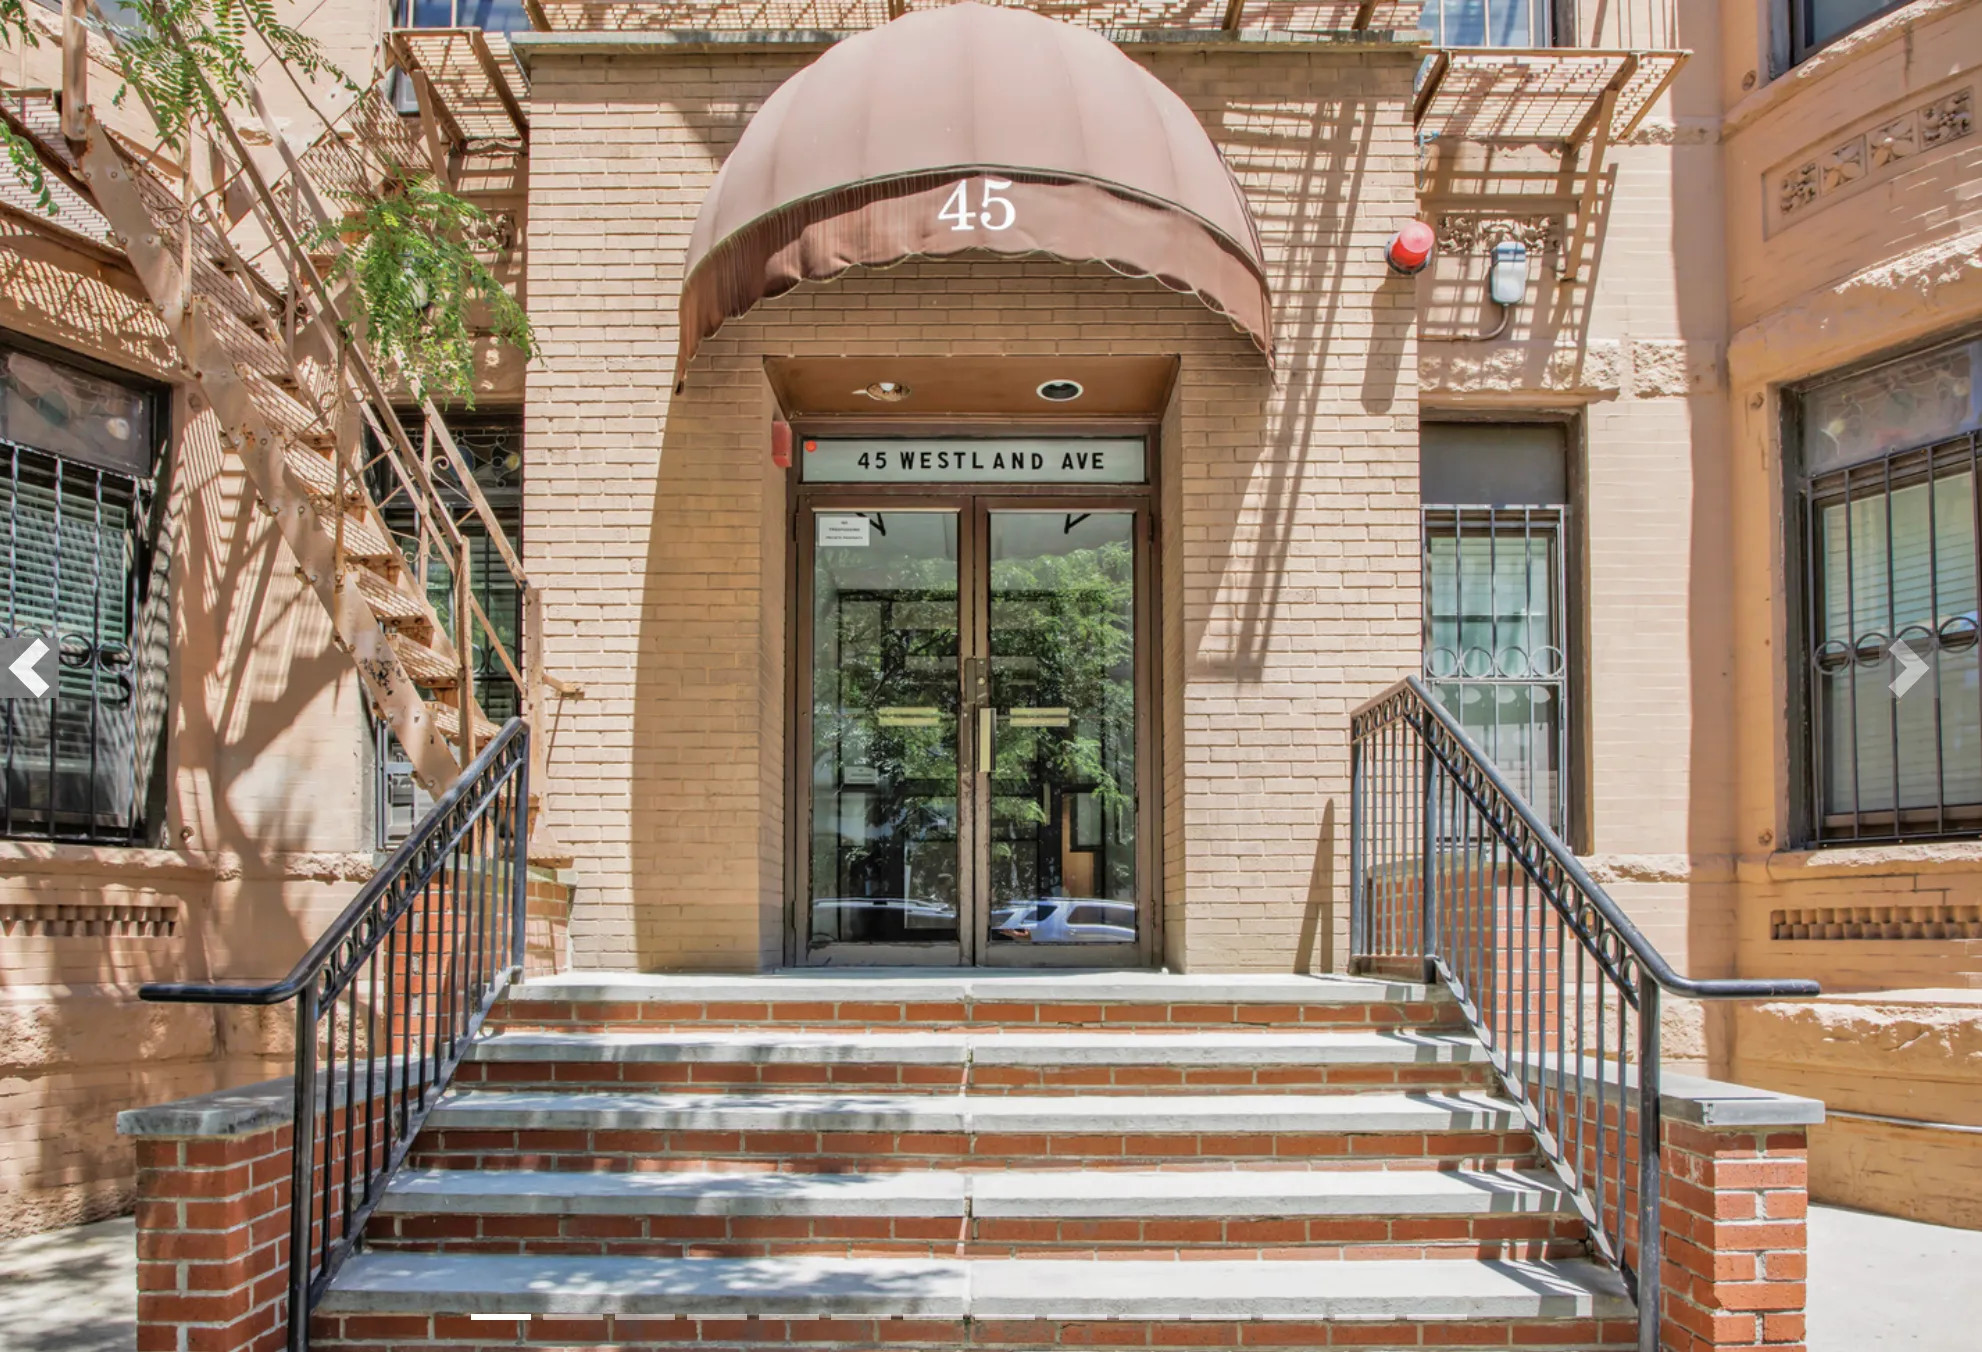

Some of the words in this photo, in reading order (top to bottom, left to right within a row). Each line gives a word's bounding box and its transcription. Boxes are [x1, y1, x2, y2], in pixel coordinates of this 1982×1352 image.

[938, 178, 1016, 231] 45
[857, 451, 888, 470] 45
[899, 451, 1044, 470] WESTLAND
[1061, 451, 1105, 470] AVE
